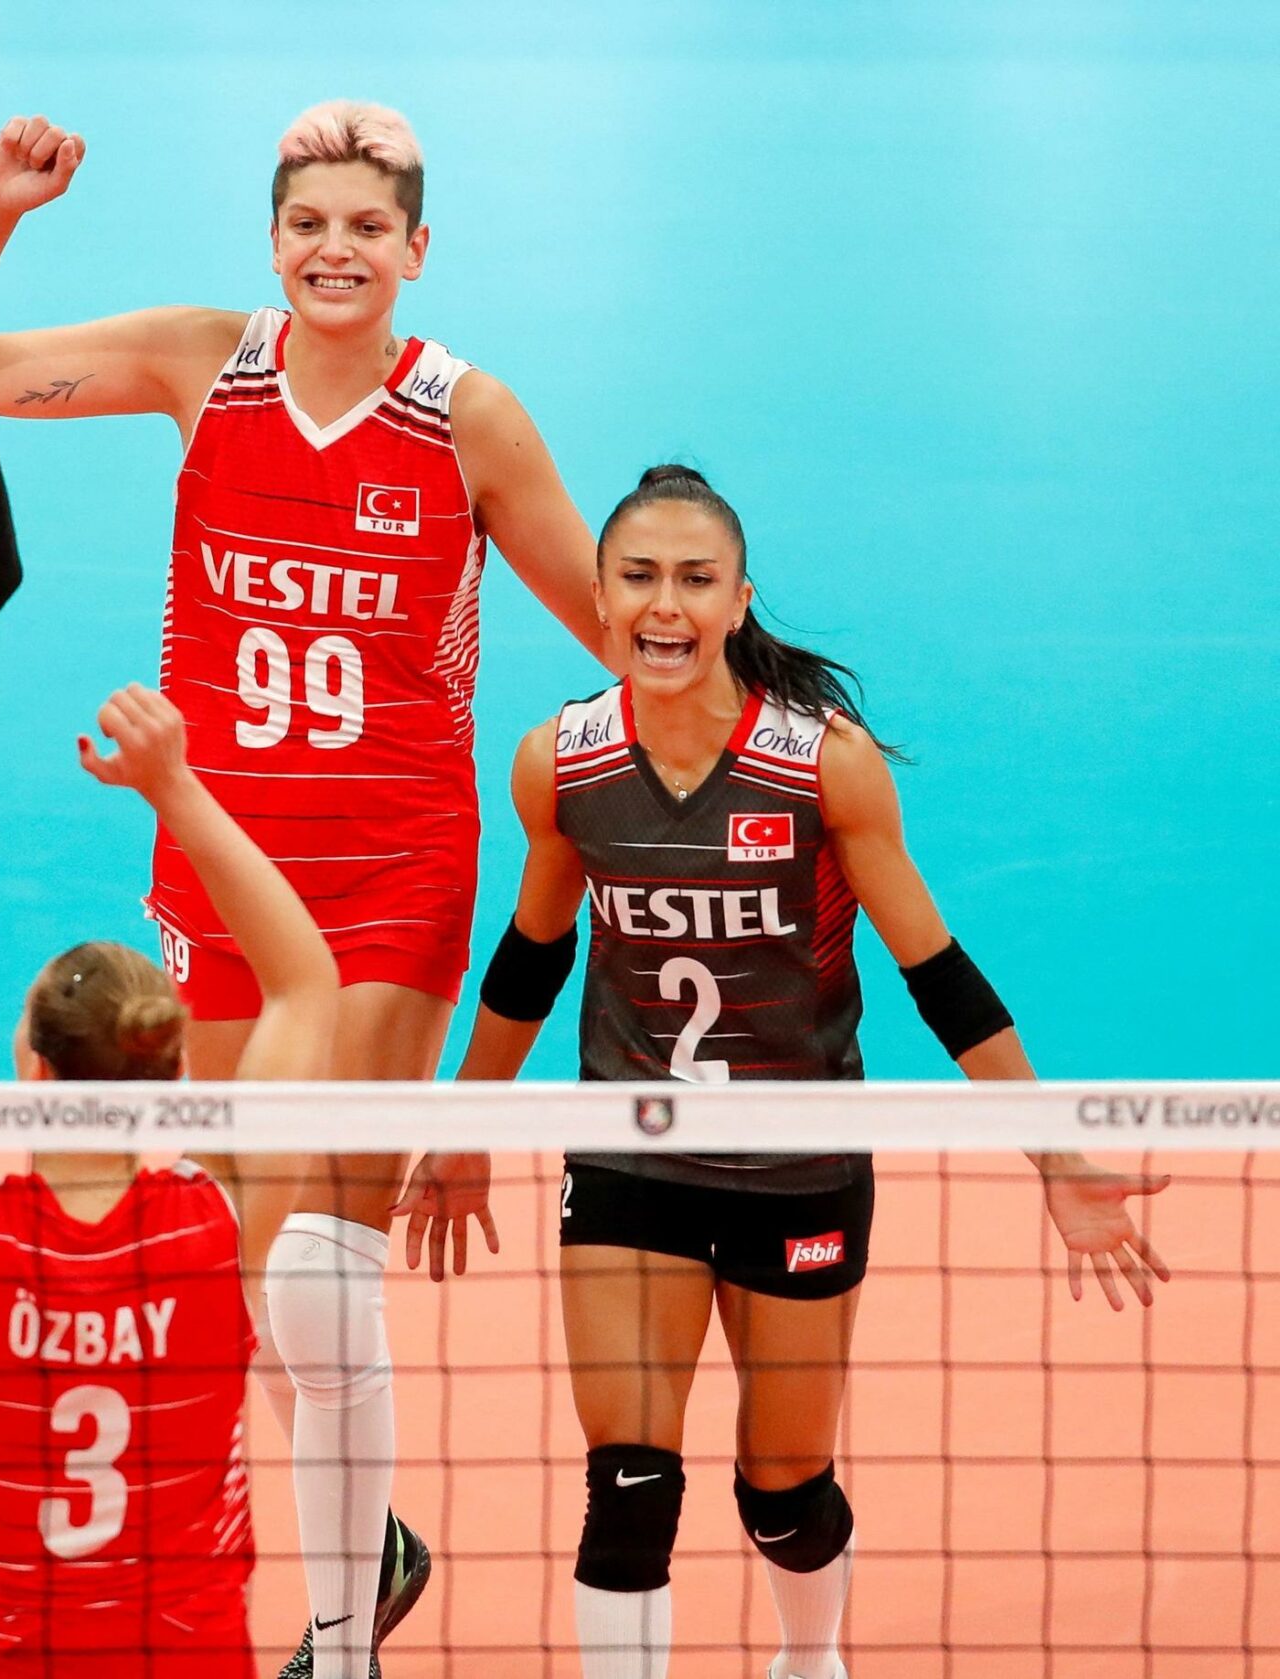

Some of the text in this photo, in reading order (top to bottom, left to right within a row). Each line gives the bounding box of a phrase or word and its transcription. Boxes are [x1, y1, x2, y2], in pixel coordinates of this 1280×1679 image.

[370, 519, 406, 533] TUR
[200, 540, 409, 621] VESTEL
[235, 626, 365, 750] 99
[753, 727, 821, 760] Orkid
[742, 848, 778, 859] TUR
[585, 874, 797, 939] VESTEL
[163, 930, 191, 984] 99
[658, 956, 731, 1083] 2
[153, 1096, 235, 1128] 2021
[1076, 1095, 1153, 1127] CEV
[561, 1172, 574, 1218] 2
[7, 1286, 178, 1367] ÖZBAY
[36, 1383, 132, 1560] 3
